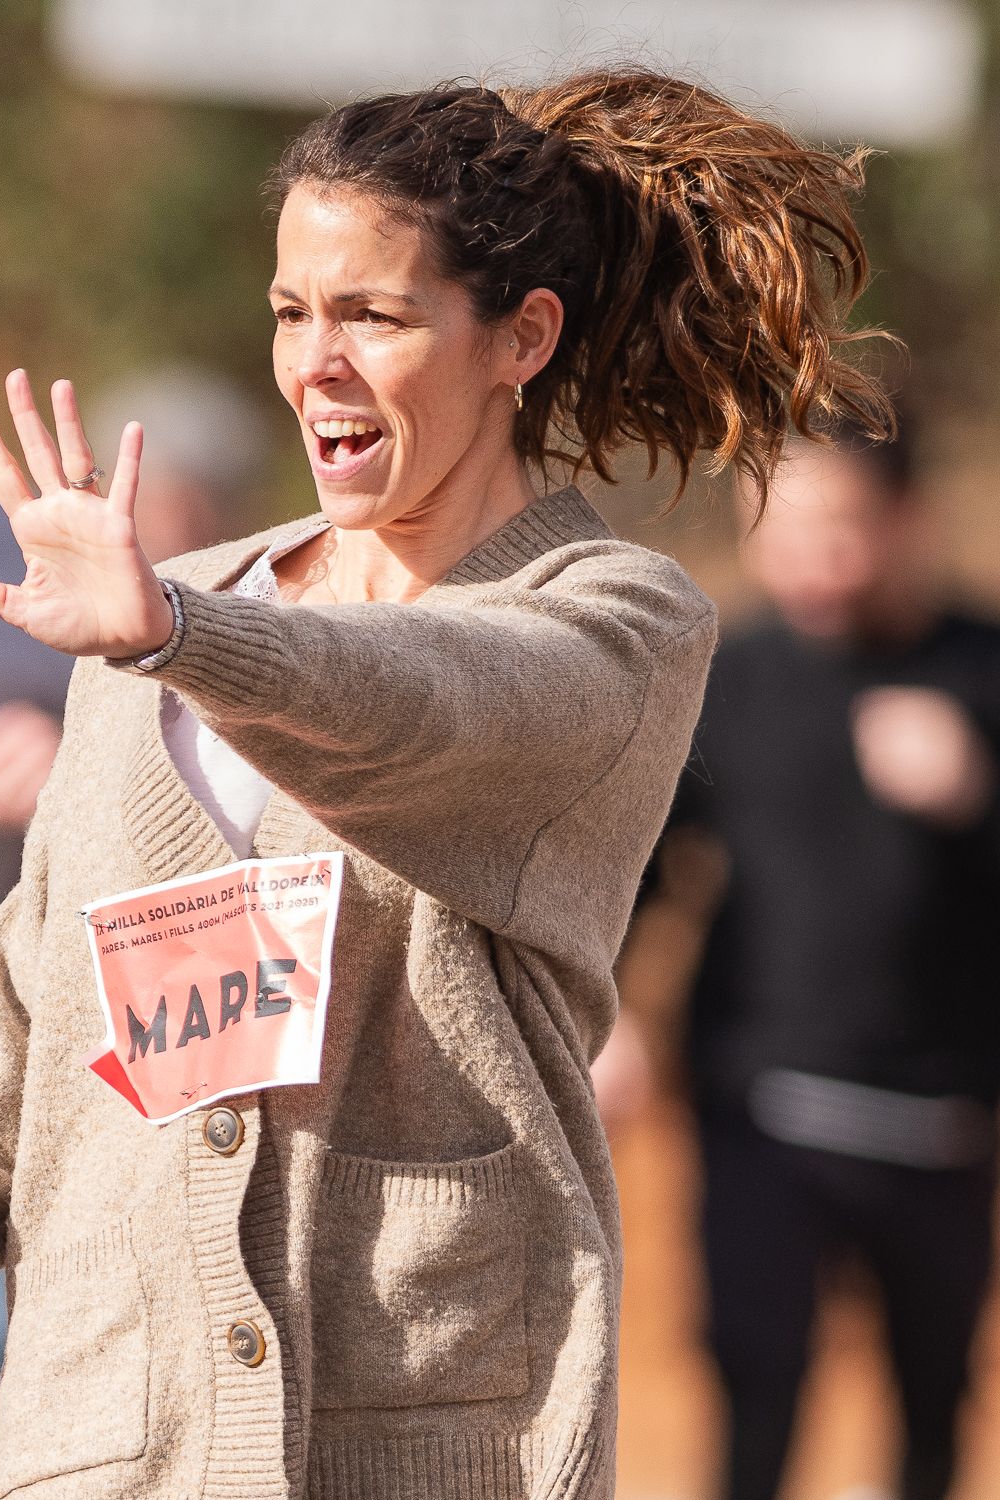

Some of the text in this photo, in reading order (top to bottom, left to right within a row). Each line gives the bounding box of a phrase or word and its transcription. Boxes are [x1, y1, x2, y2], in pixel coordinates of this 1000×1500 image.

[101, 940, 128, 955] PARES,
[131, 931, 163, 947] MARES
[169, 923, 195, 938] FILLS
[197, 916, 220, 930] 400M
[221, 903, 257, 925] (NASCUS
[107, 912, 146, 933] MILLA
[148, 893, 217, 922] SOLIDÀRIA
[220, 887, 234, 902] DE
[126, 958, 298, 1065] MARE
